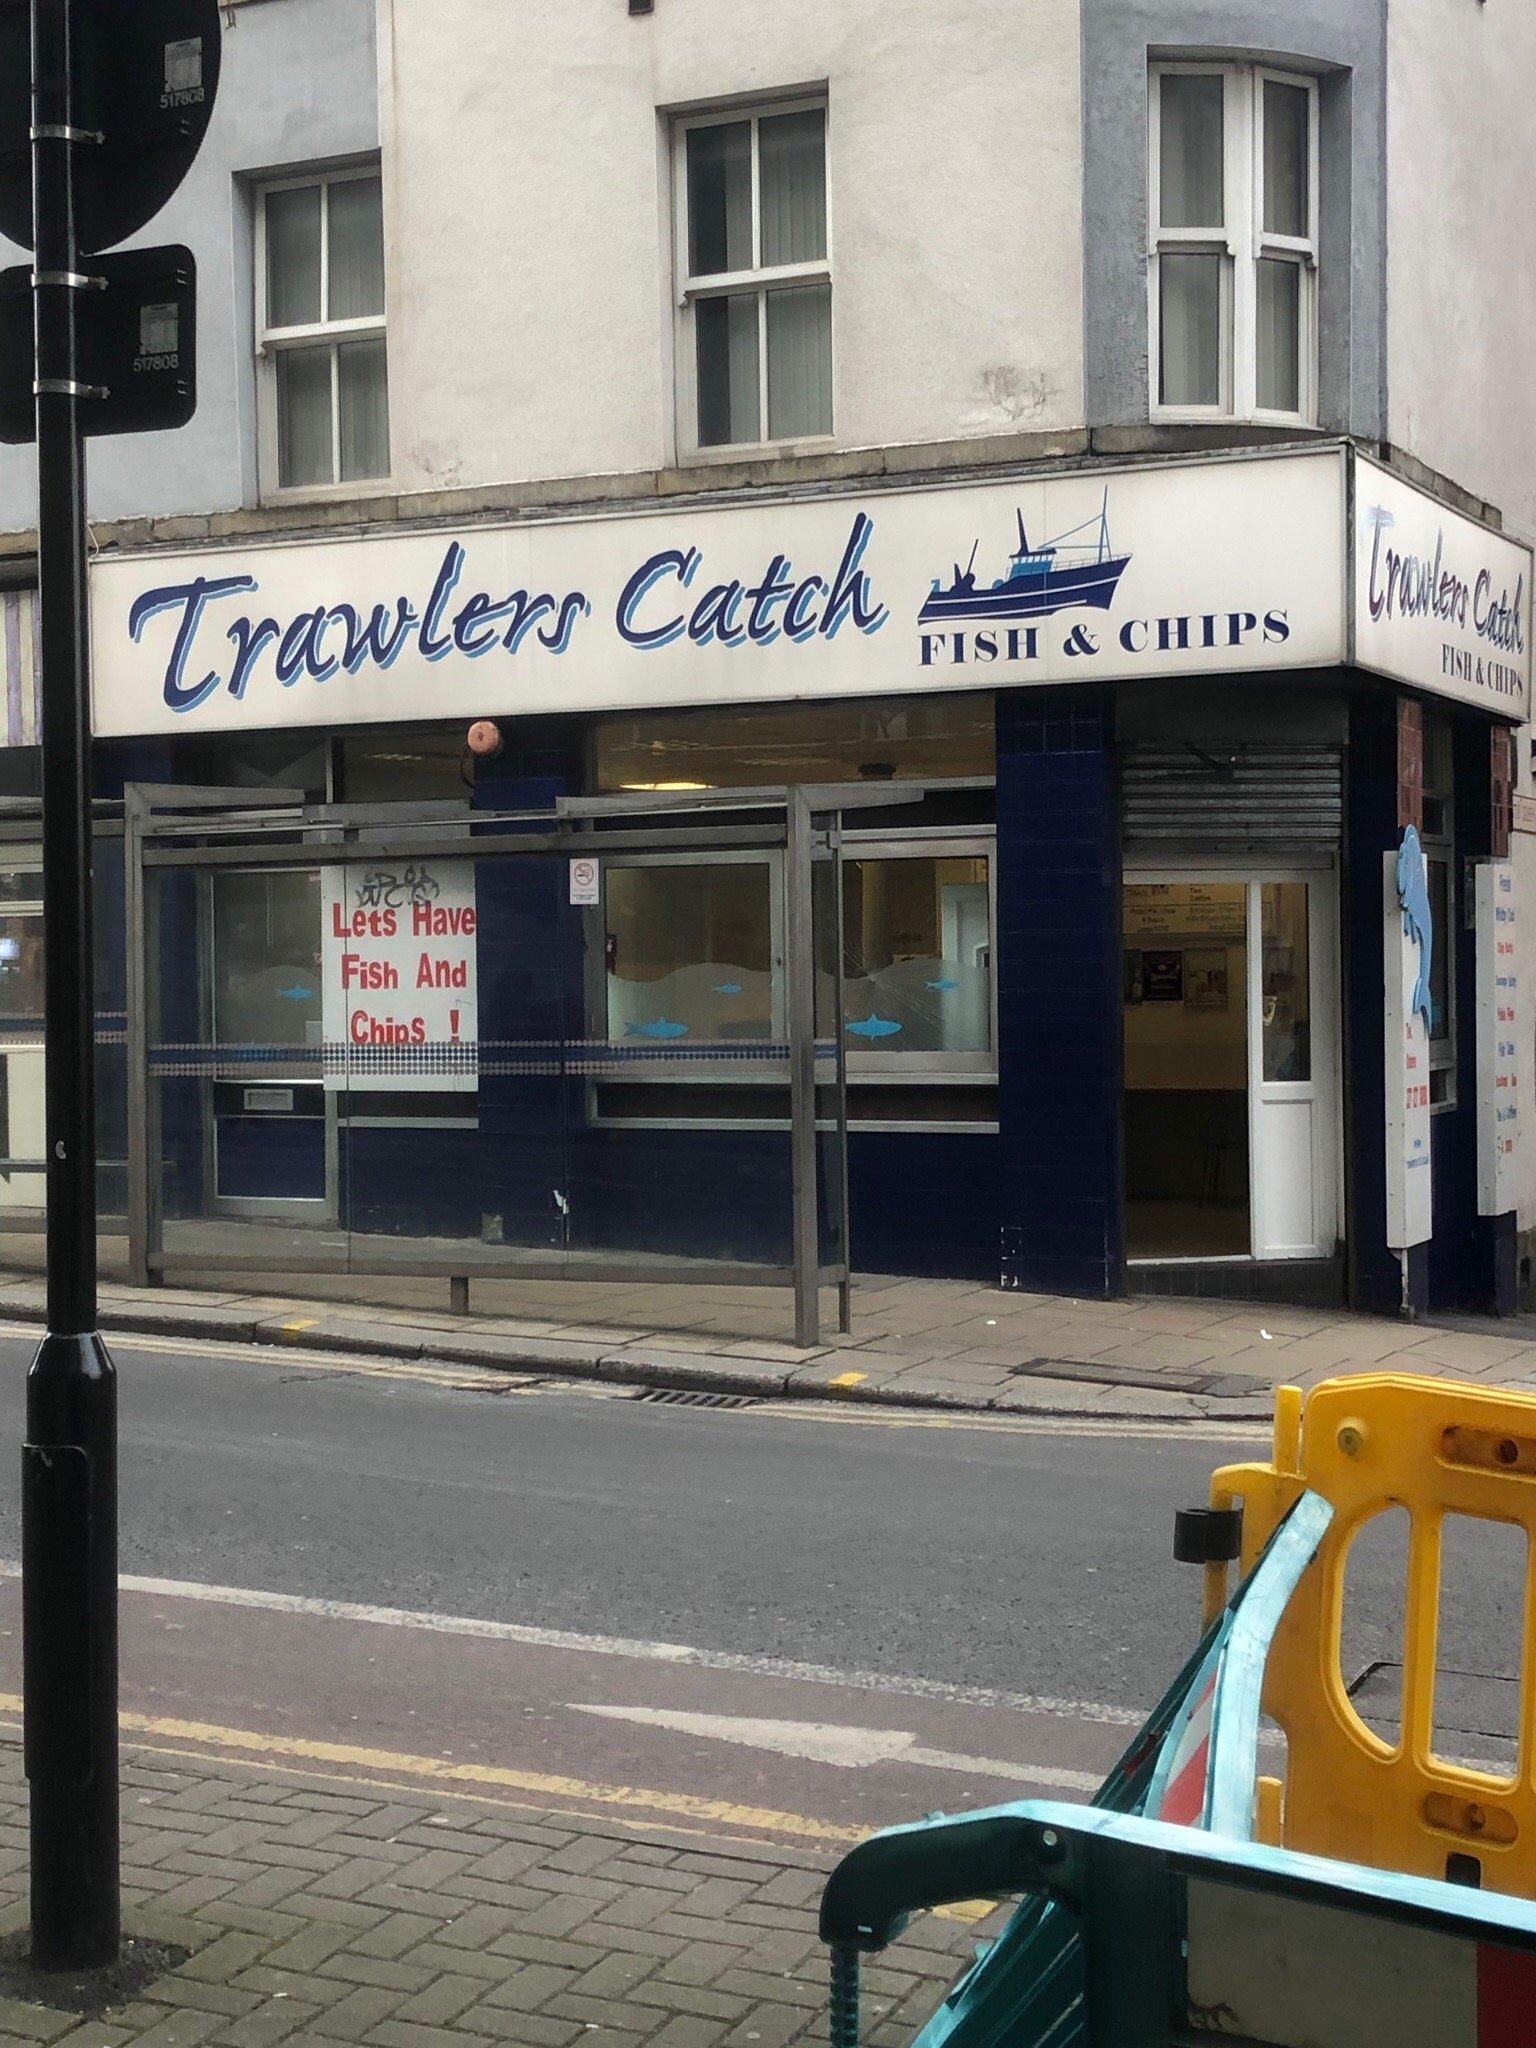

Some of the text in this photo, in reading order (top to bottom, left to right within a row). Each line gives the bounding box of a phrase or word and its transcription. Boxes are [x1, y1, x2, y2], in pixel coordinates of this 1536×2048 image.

[1368, 504, 1524, 655] Trawlers Catch
[129, 512, 890, 713] Trawlers Catch
[917, 608, 1291, 667] FISH & CHIPS
[1442, 643, 1523, 697] FISH & CHIPS
[333, 901, 477, 938] Lets Have
[341, 952, 467, 989] Fish And
[351, 1010, 426, 1045] Chips
